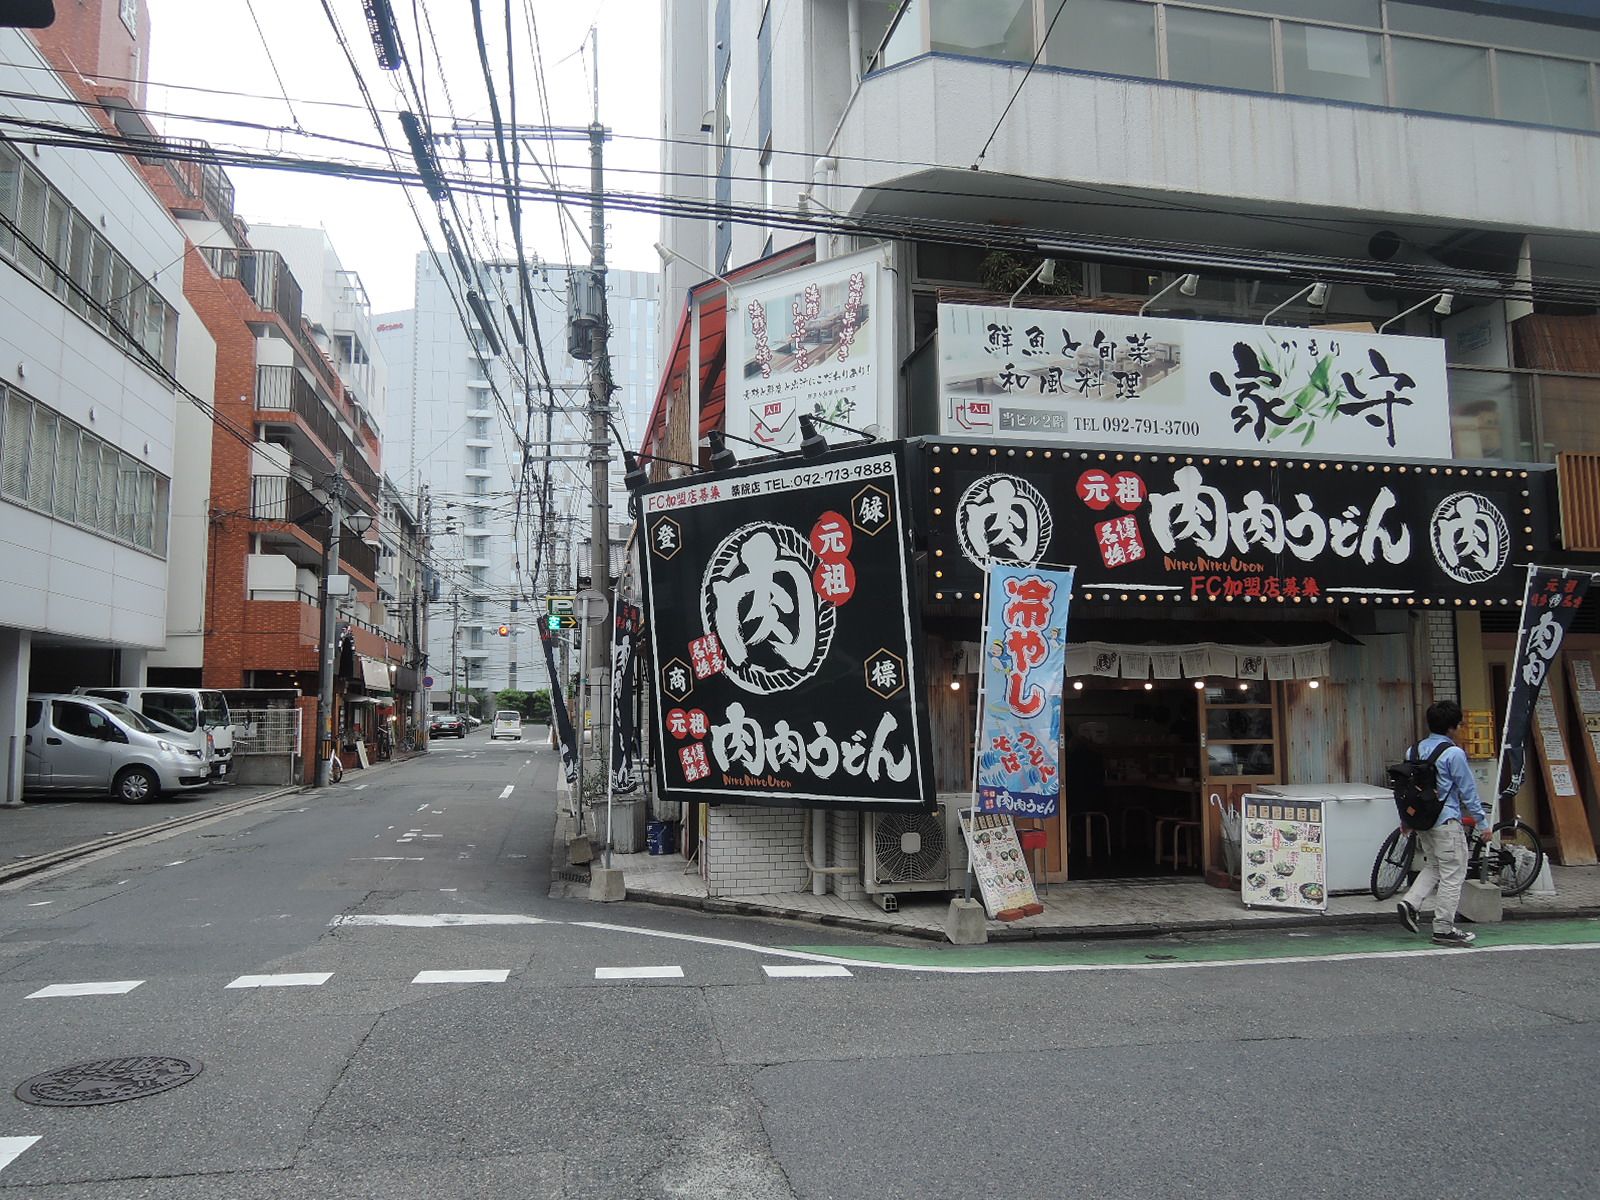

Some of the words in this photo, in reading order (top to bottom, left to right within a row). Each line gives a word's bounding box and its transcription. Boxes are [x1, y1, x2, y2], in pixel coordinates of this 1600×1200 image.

[984, 323, 1152, 367] 鮮魚と旬菜
[1281, 339, 1341, 357] かもり
[999, 363, 1141, 399] 和風料理
[1209, 341, 1416, 448] 家守
[971, 404, 990, 413] 入口
[1002, 411, 1065, 430] 当ビル2階
[1073, 416, 1100, 432] TEL
[1102, 416, 1200, 437] 092-791-3700
[649, 485, 721, 510] FC加盟店募集
[1083, 476, 1142, 503] 元祖
[858, 495, 886, 526] 録
[965, 480, 1040, 557] 肉
[1148, 465, 1410, 564] 肉肉うどん
[656, 524, 678, 551] 登
[1438, 497, 1498, 571] 肉
[816, 523, 850, 596] 元祖
[712, 531, 818, 670] 肉
[1190, 576, 1321, 598] FC加盟店募集
[1006, 579, 1053, 715] 冷やし
[668, 667, 687, 692] 商
[871, 659, 898, 688] 標
[670, 713, 707, 734] 元祖
[710, 701, 912, 783] 肉肉うどん
[992, 736, 1021, 774] そば
[1018, 732, 1056, 784] うどん
[996, 790, 1055, 815] 肉肉うどん
